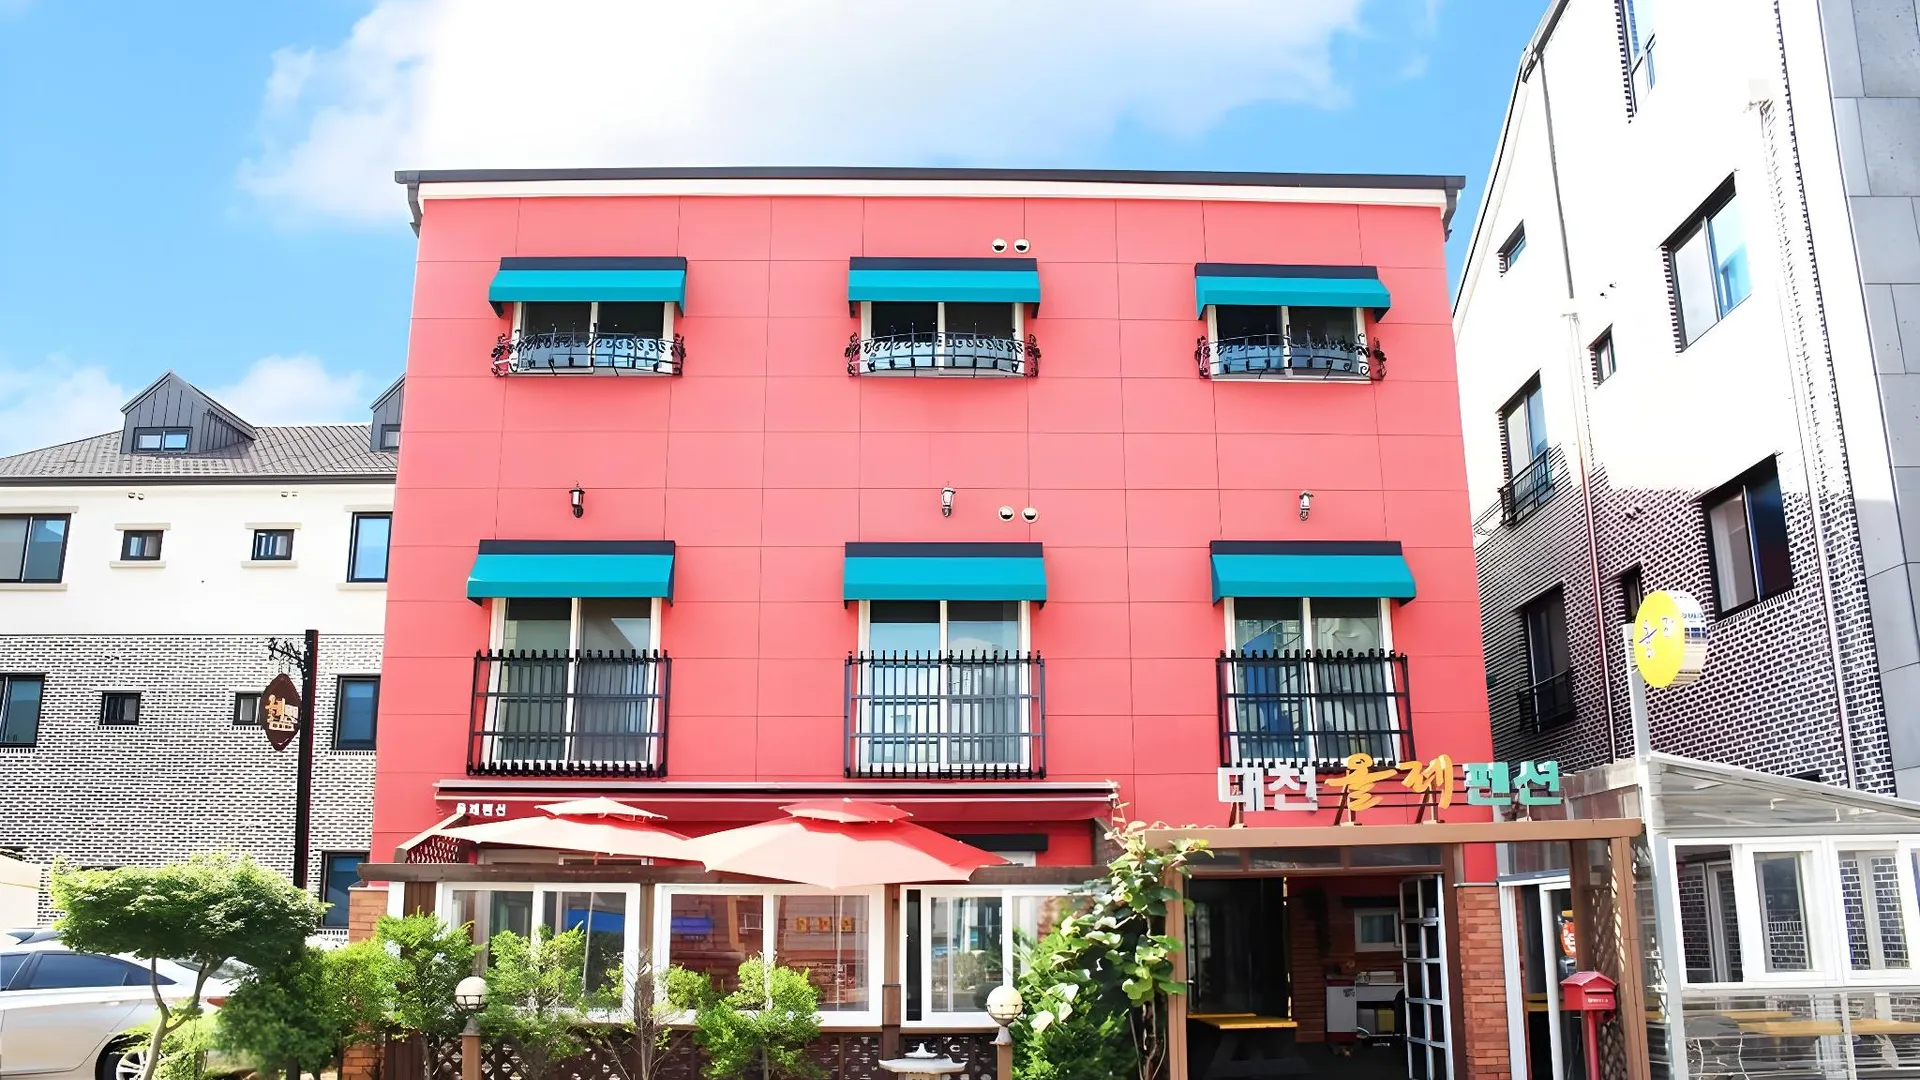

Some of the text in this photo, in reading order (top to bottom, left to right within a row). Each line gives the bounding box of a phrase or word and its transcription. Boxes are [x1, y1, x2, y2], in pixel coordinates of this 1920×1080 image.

[1217, 752, 1562, 812] 대천 올레 펜션
